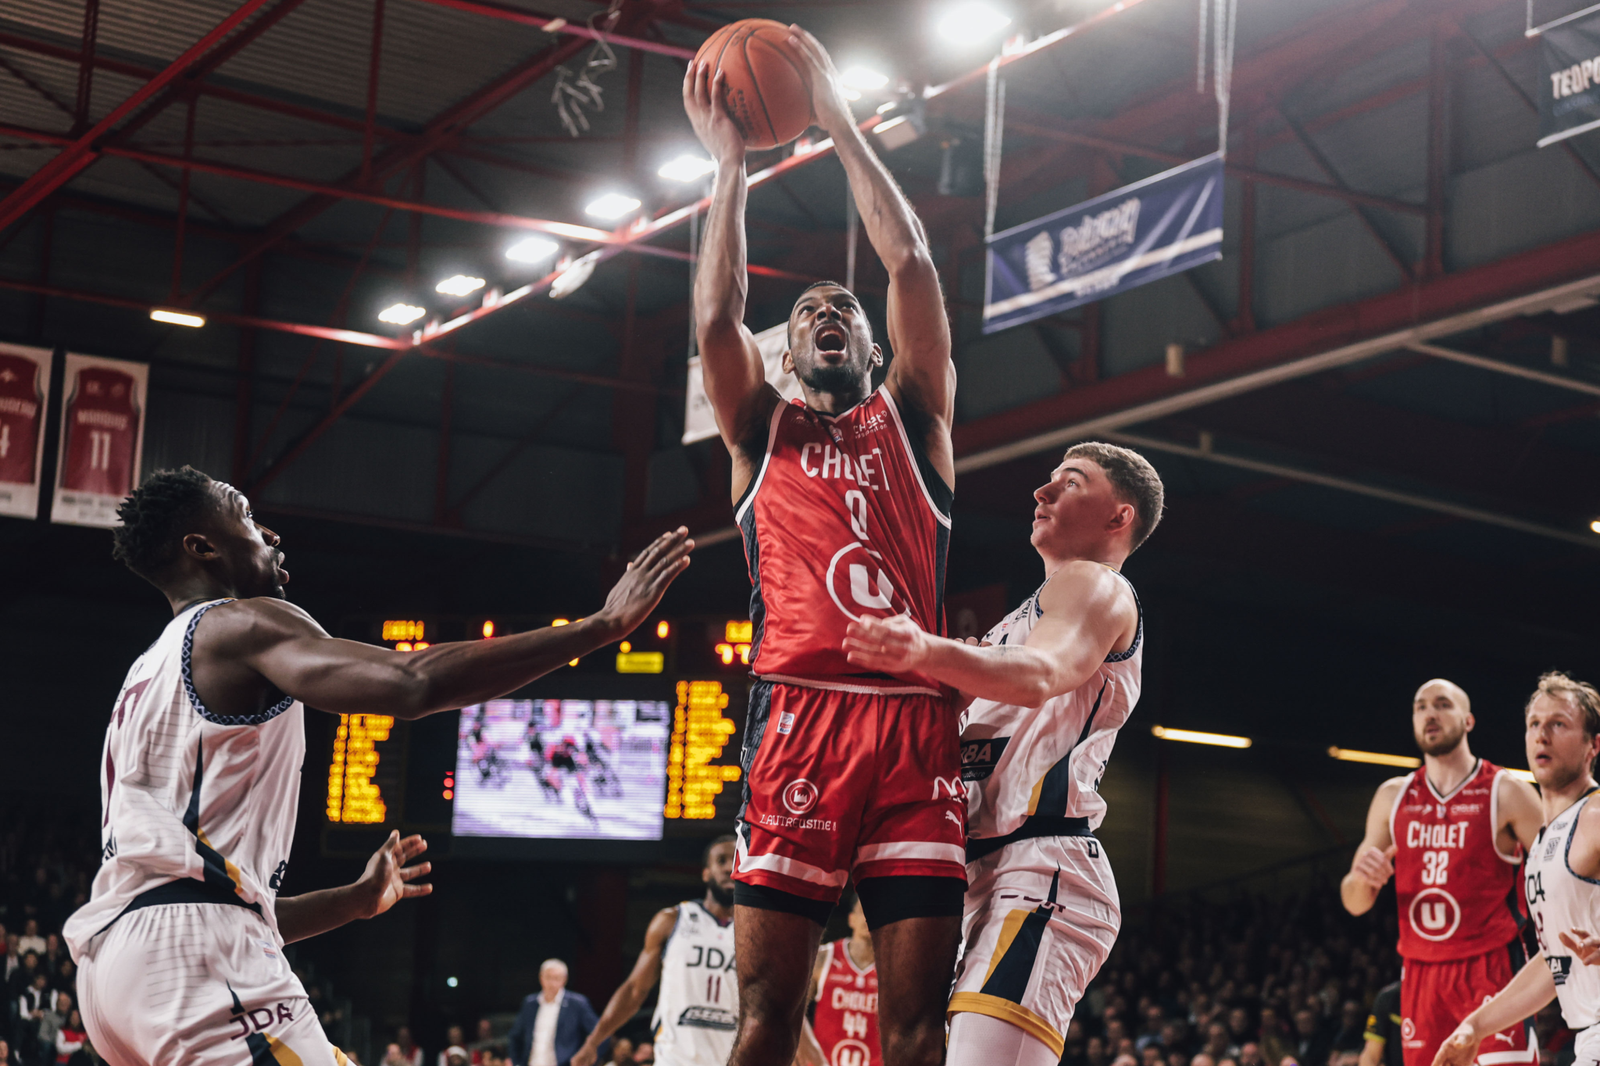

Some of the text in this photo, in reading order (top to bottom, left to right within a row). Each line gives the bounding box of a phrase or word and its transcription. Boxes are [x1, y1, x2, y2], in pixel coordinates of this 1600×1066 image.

[90, 430, 111, 471] 11
[800, 442, 890, 491] CHOLET
[845, 489, 870, 540] 0
[1406, 820, 1469, 849] CHOLET
[1421, 851, 1449, 885] 32
[706, 975, 721, 1004] 11
[229, 1003, 294, 1040] JDA
[843, 1010, 867, 1039] 44
